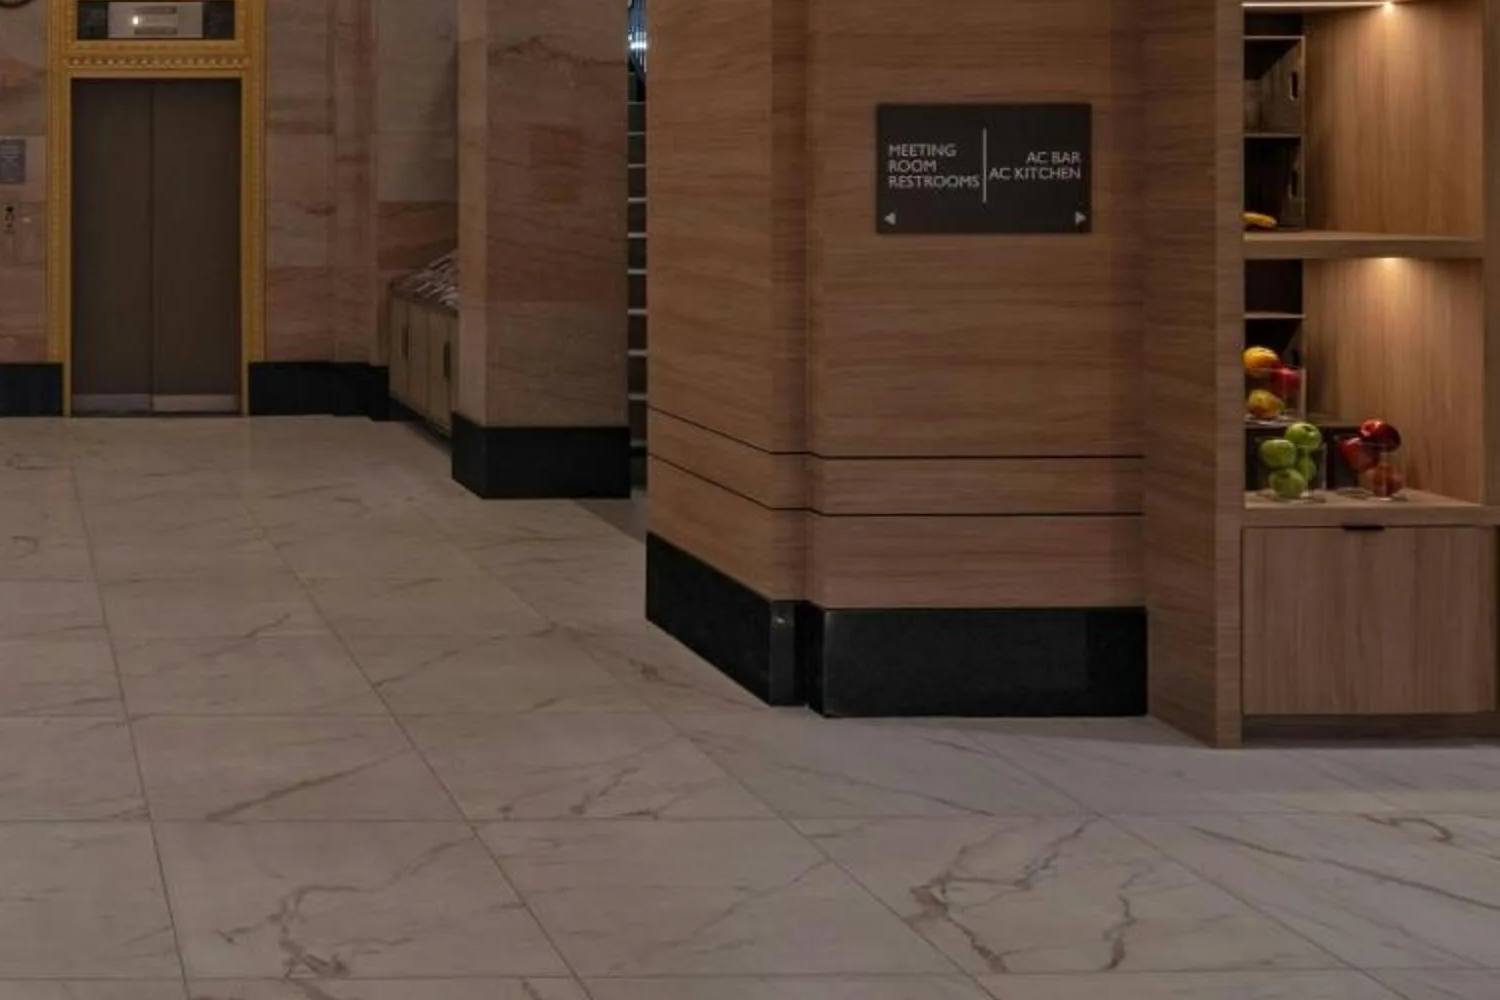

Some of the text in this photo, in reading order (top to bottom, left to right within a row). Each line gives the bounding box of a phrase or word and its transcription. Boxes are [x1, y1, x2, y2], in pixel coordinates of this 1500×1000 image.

[888, 143, 957, 157] MEETING
[1026, 151, 1081, 164] AC BAR
[888, 159, 937, 173] ROOM
[988, 167, 1081, 180] AC KITCHEN
[888, 175, 980, 189] RESTROOMS
